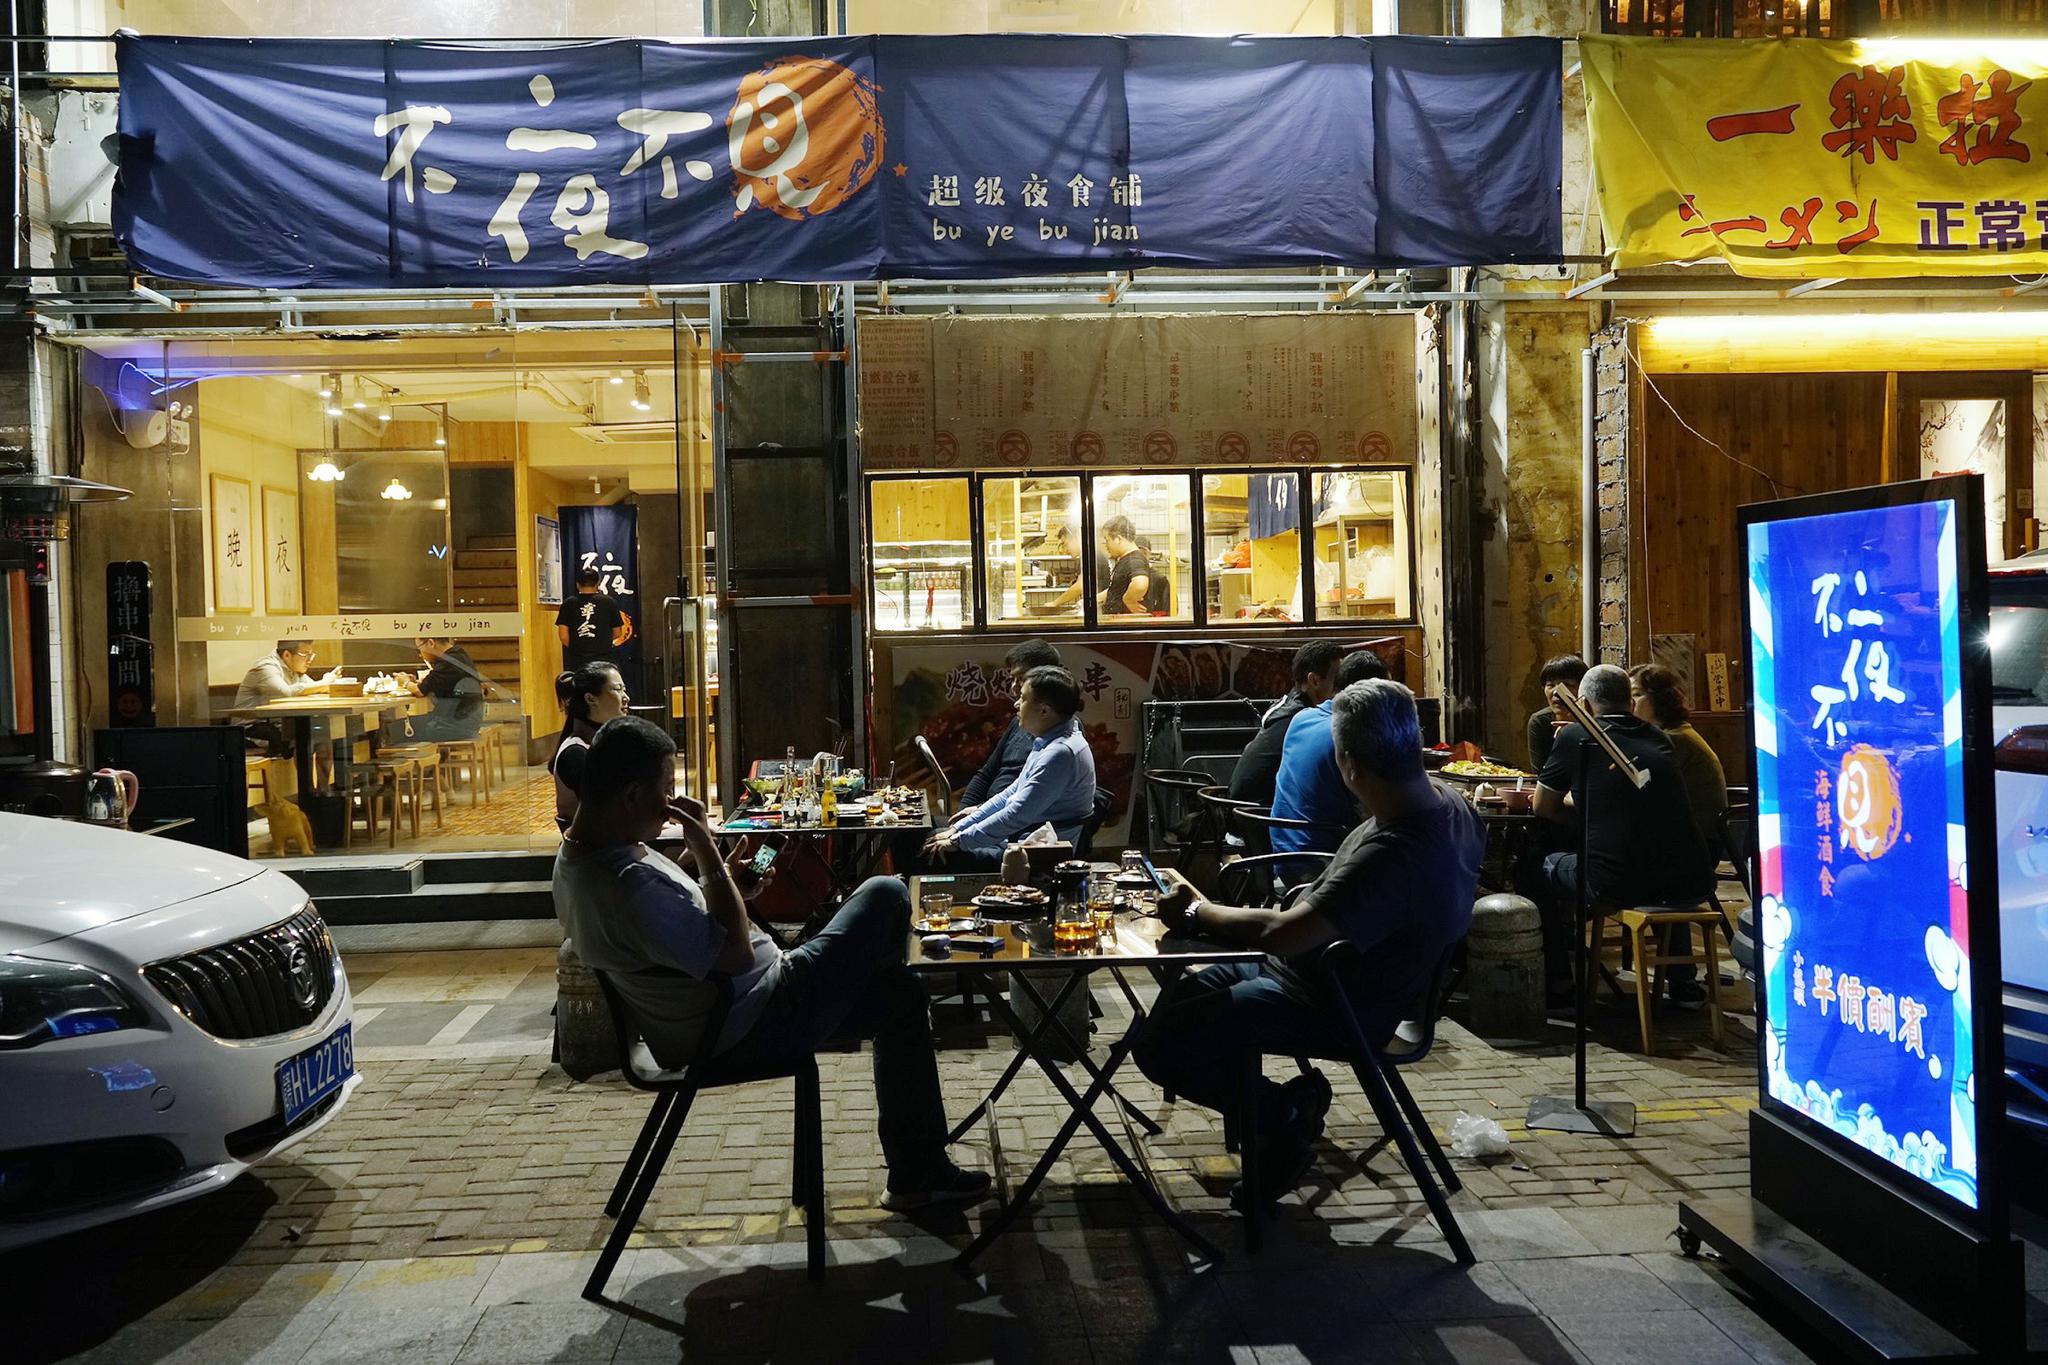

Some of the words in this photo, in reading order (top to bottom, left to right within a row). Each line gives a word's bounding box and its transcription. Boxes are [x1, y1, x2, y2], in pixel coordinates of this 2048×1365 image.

[928, 172, 1143, 208] 超级夜食铺
[932, 218, 961, 241] bu
[986, 225, 1015, 246] ye
[1039, 218, 1068, 241] bu
[1093, 218, 1139, 247] jian
[227, 528, 242, 567] 晚
[276, 535, 291, 574] 夜
[210, 623, 224, 632] bu
[235, 624, 249, 636] ye
[394, 620, 407, 630] bu
[419, 621, 432, 632] ye
[443, 619, 457, 629] bu
[469, 618, 490, 632] jian
[1812, 964, 1928, 1060] 半價酬賓
